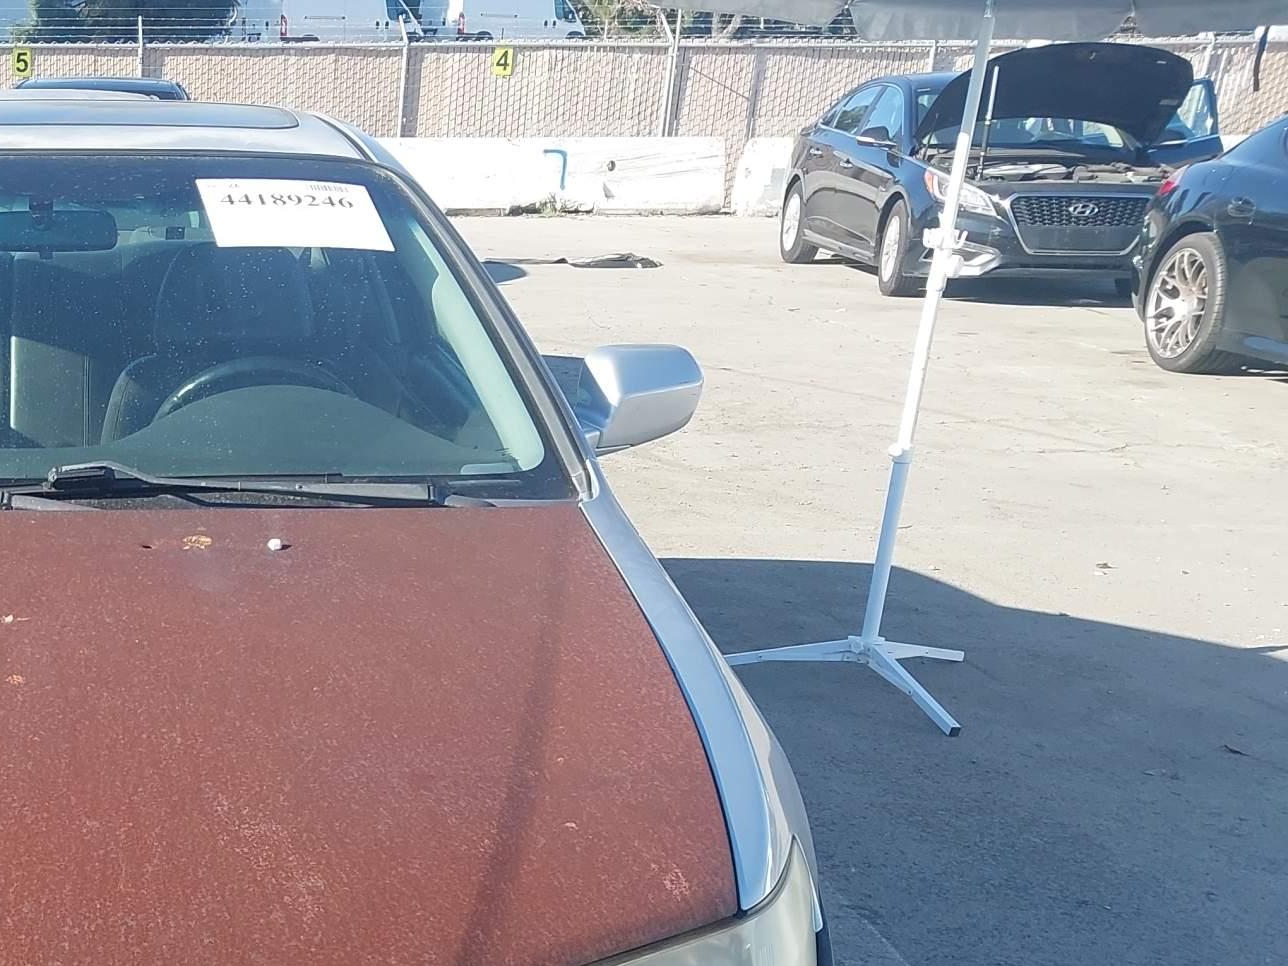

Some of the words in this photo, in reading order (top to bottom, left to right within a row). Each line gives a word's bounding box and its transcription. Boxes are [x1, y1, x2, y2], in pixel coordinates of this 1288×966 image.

[16, 52, 29, 73] 5
[495, 50, 510, 71] 4
[220, 193, 355, 209] 44189246
